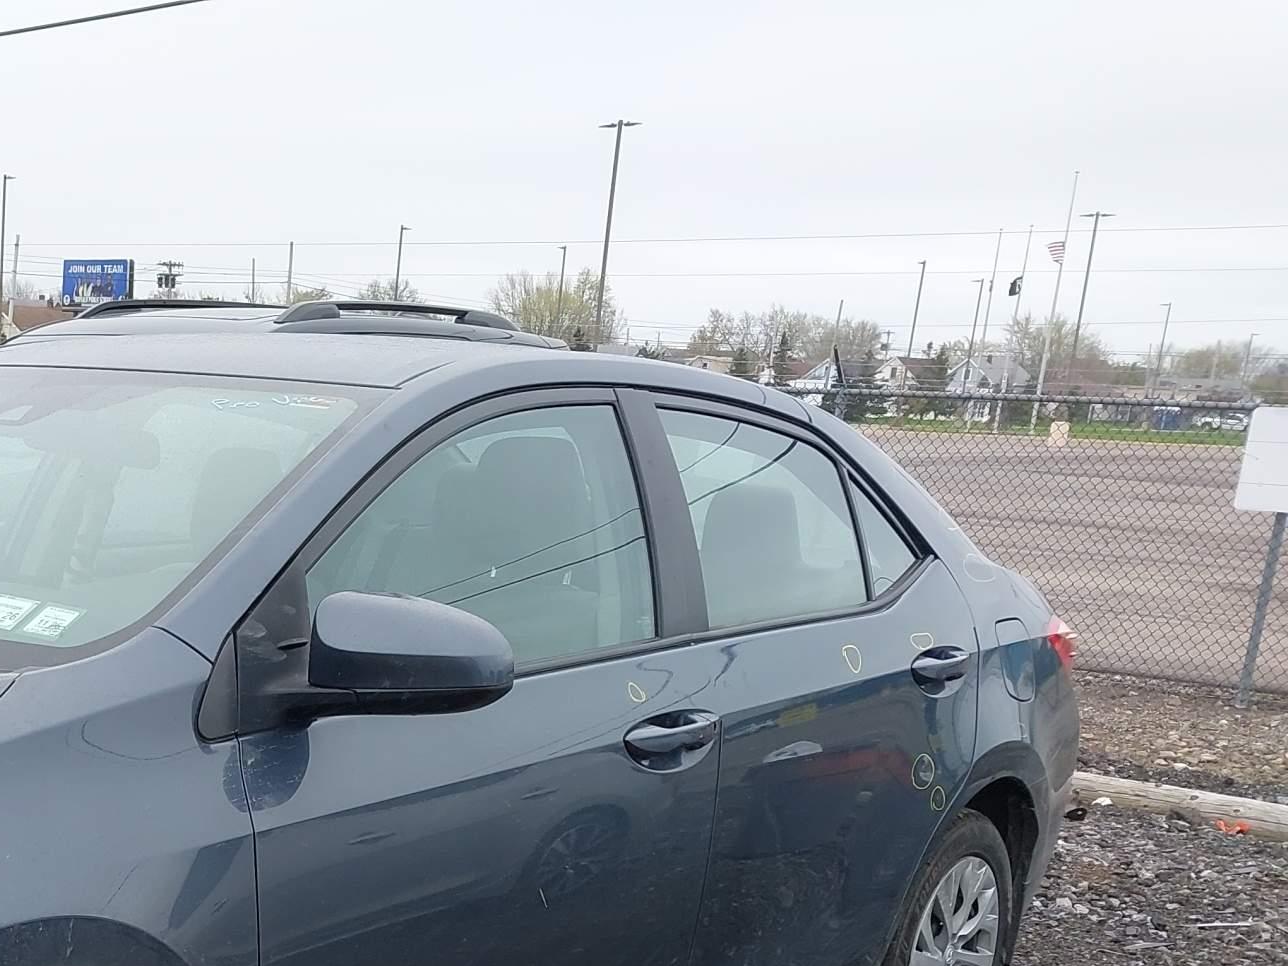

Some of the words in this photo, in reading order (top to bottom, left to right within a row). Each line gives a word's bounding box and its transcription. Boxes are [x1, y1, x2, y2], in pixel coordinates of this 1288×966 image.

[68, 264, 85, 273] JOIN
[86, 264, 102, 273] OUR
[103, 264, 124, 273] TEAM
